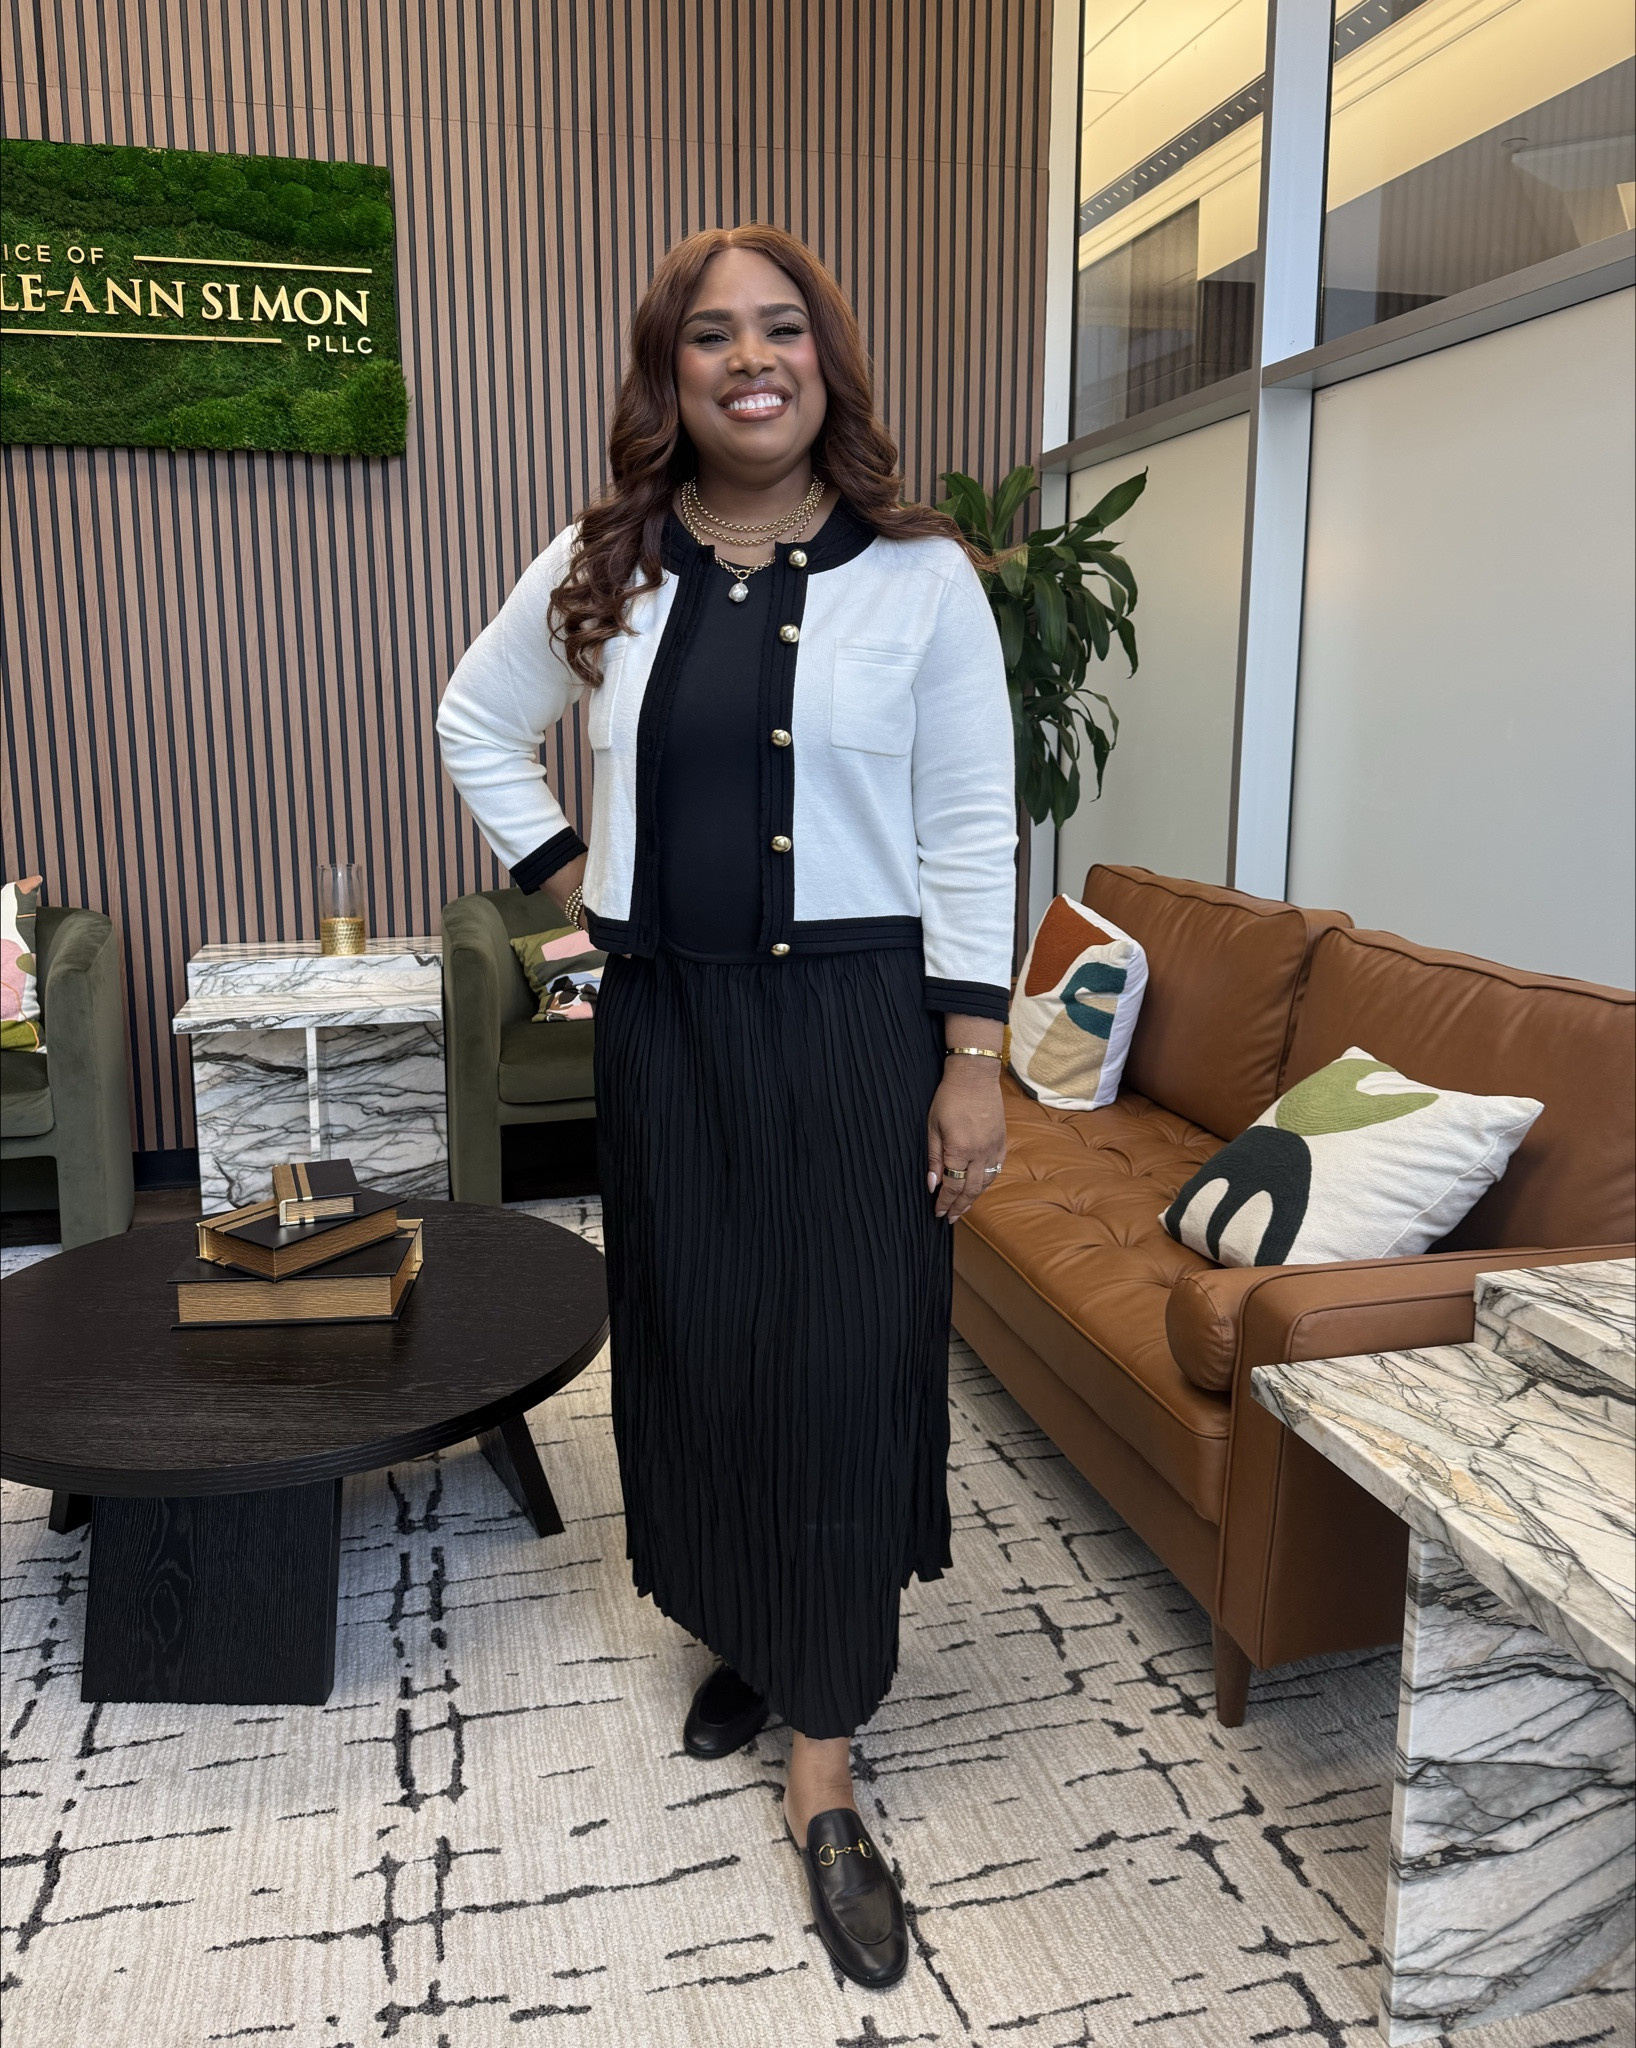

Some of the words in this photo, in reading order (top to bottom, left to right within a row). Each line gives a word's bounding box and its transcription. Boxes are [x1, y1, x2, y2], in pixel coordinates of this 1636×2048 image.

[3, 243, 51, 263] ICE
[67, 246, 104, 265] OF
[0, 273, 186, 319] LE-ANN
[201, 282, 370, 327] SIMON
[307, 334, 373, 354] PLLC
